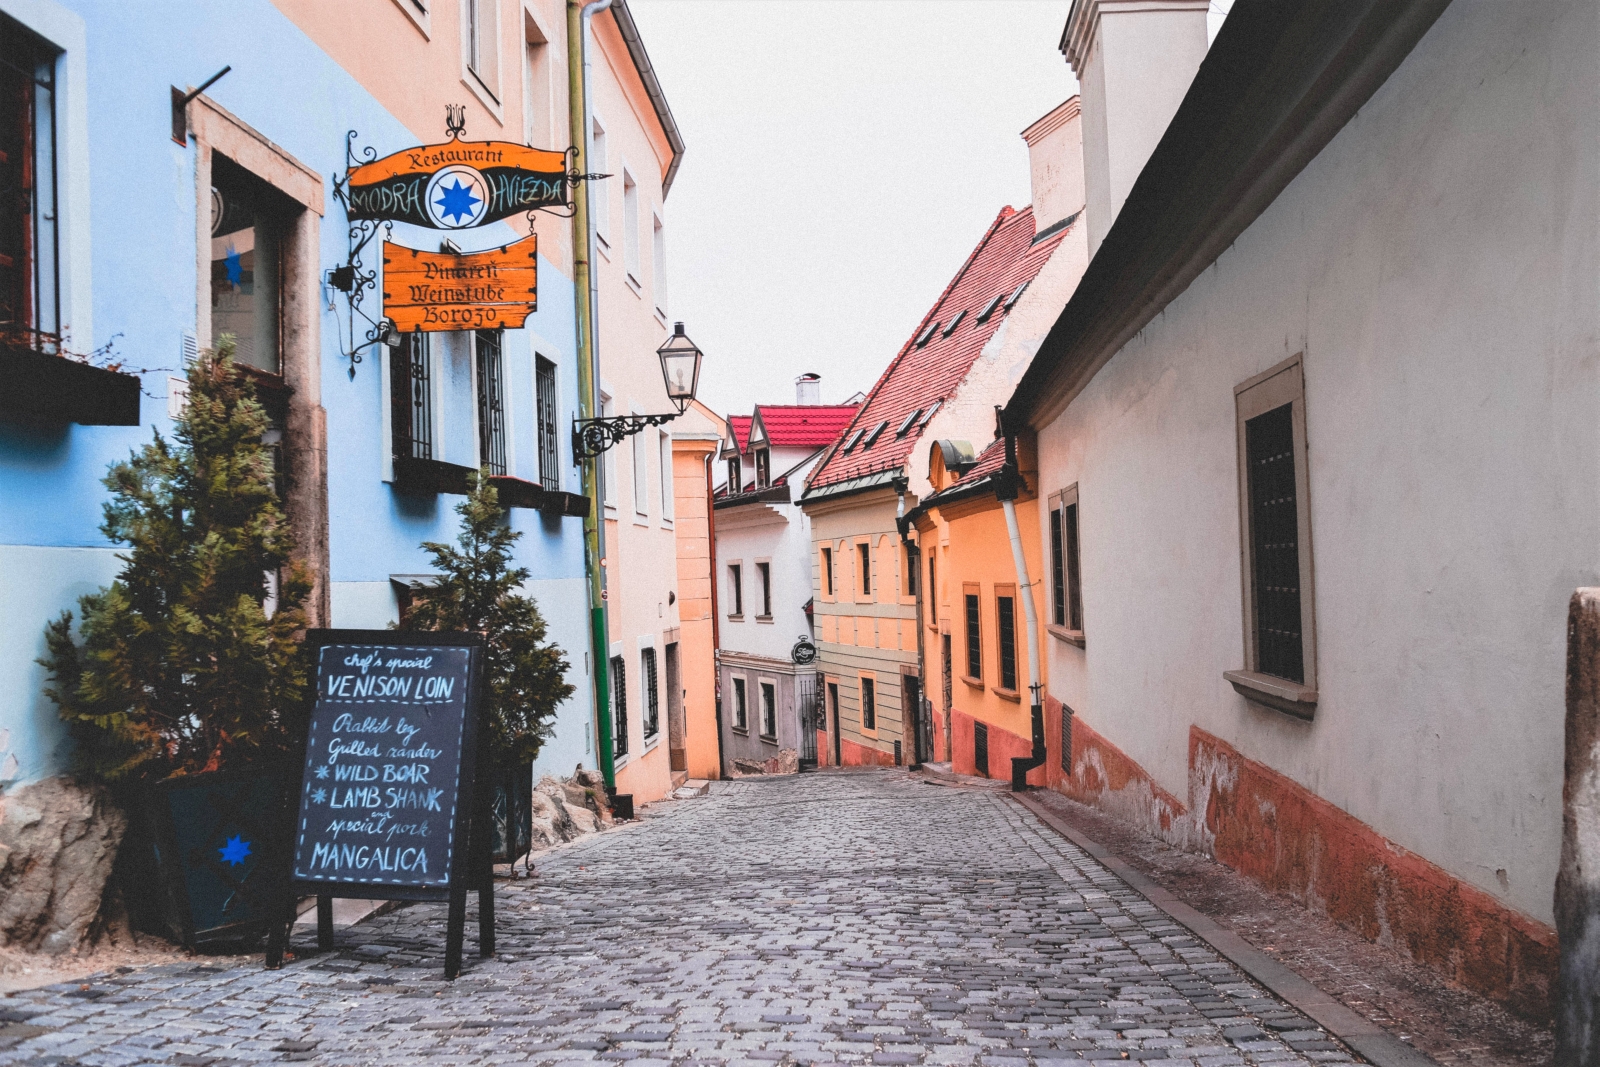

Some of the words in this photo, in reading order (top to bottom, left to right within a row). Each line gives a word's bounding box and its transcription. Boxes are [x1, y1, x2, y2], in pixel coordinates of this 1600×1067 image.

[406, 150, 503, 170] Restaurant
[408, 284, 505, 302] Weinstube
[344, 650, 382, 675] chef's
[386, 656, 433, 674] special
[327, 675, 412, 698] VENISON
[414, 676, 455, 699] LOIN
[332, 713, 392, 734] Rabbit
[395, 717, 421, 746] leg
[328, 738, 382, 764] Grilled
[335, 764, 379, 782] WILD
[382, 763, 430, 784] BOAR
[330, 786, 381, 809] LAMB
[384, 787, 444, 812] SHANK
[371, 810, 394, 819] and
[325, 818, 387, 840] special
[386, 820, 432, 843] pork
[310, 842, 428, 874] MANGALICA
